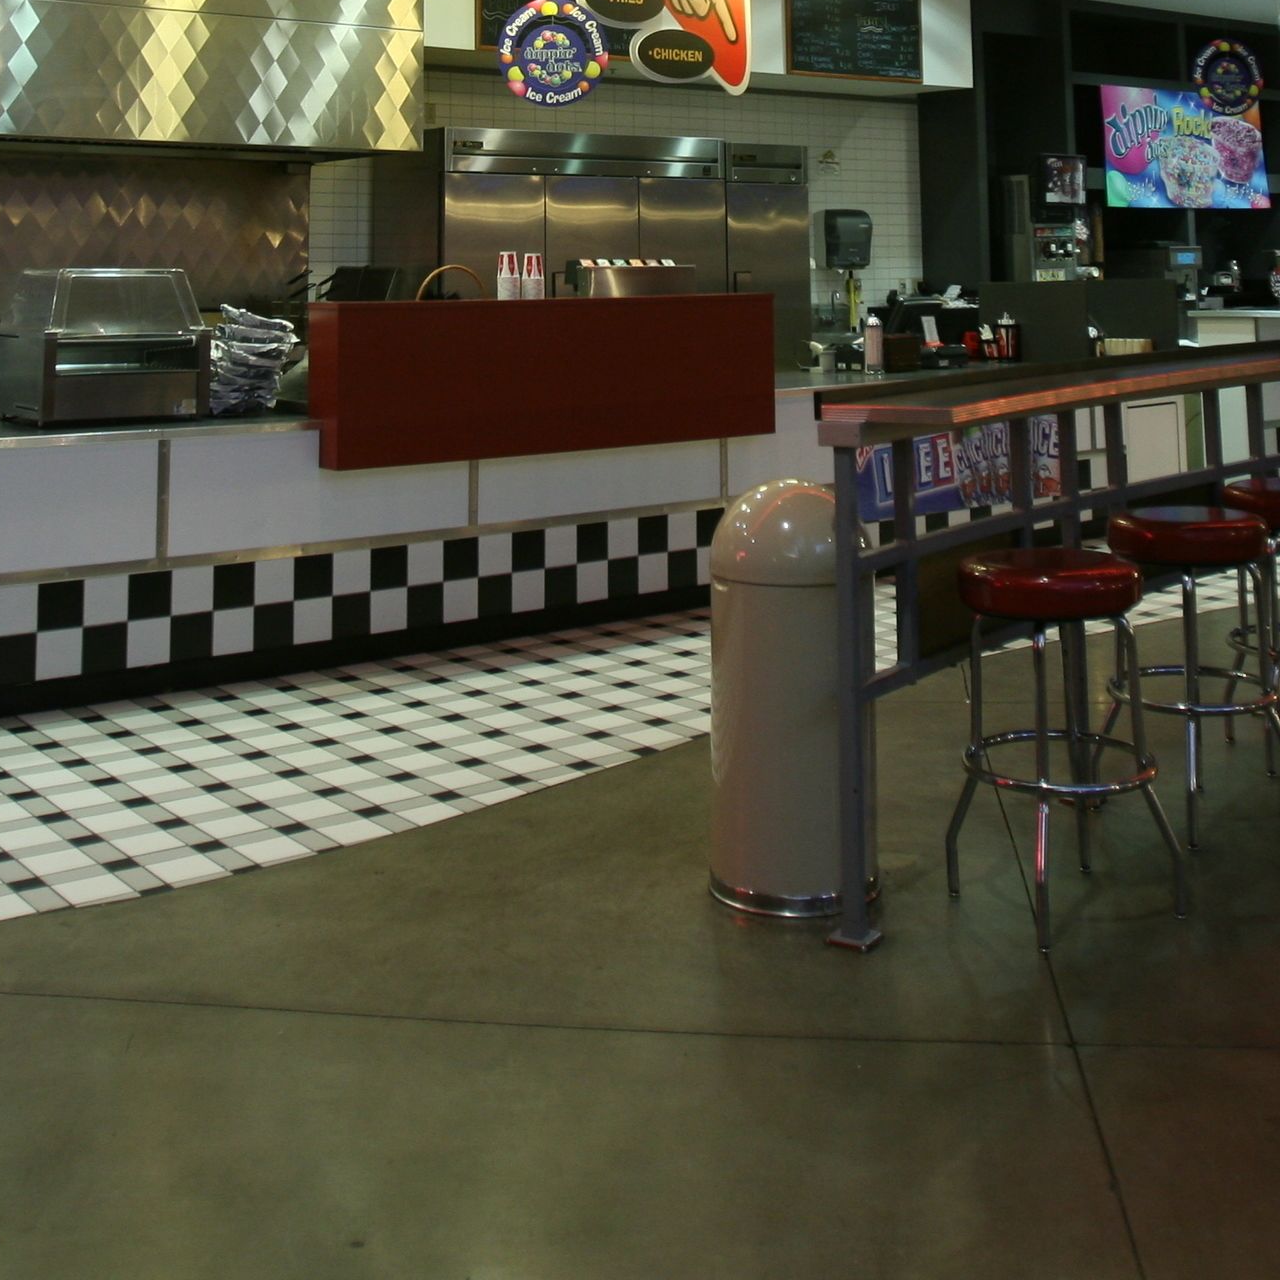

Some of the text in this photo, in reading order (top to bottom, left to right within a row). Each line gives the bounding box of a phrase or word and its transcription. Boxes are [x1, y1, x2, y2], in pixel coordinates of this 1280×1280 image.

[499, 7, 537, 56] Ice Cream
[569, 6, 604, 56] Ice Cream
[652, 47, 703, 62] CHICKEN
[525, 87, 583, 104] Ice Cream
